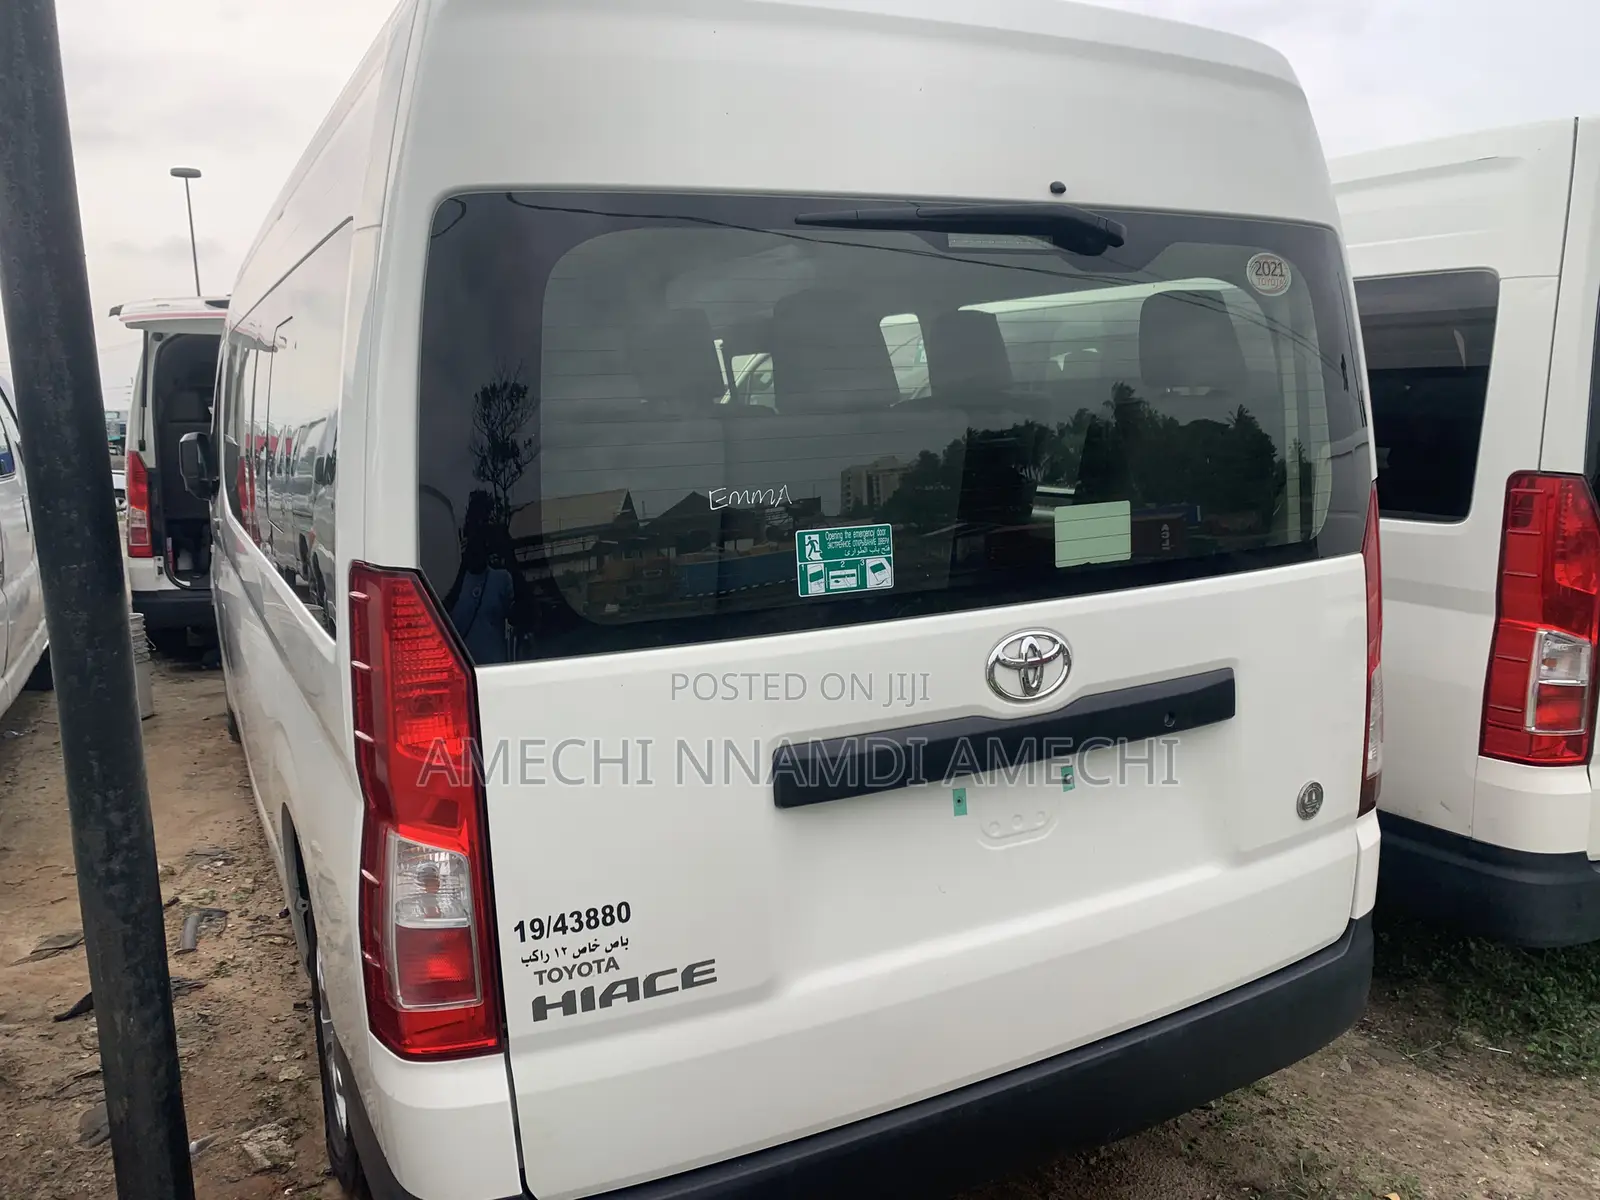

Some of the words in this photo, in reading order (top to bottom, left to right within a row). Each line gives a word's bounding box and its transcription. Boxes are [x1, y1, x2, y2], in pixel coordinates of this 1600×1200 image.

[1254, 260, 1286, 277] 2021
[825, 530, 843, 541] Opening
[844, 530, 852, 539] the
[853, 528, 875, 541] emergency
[876, 527, 887, 536] door
[513, 901, 632, 943] 19/43880
[555, 946, 568, 958] ١٢
[572, 938, 600, 959] خاص
[604, 936, 630, 953] باص
[521, 949, 550, 967] راكب
[534, 956, 620, 986] TOYOTA
[531, 958, 718, 1022] HIACE
